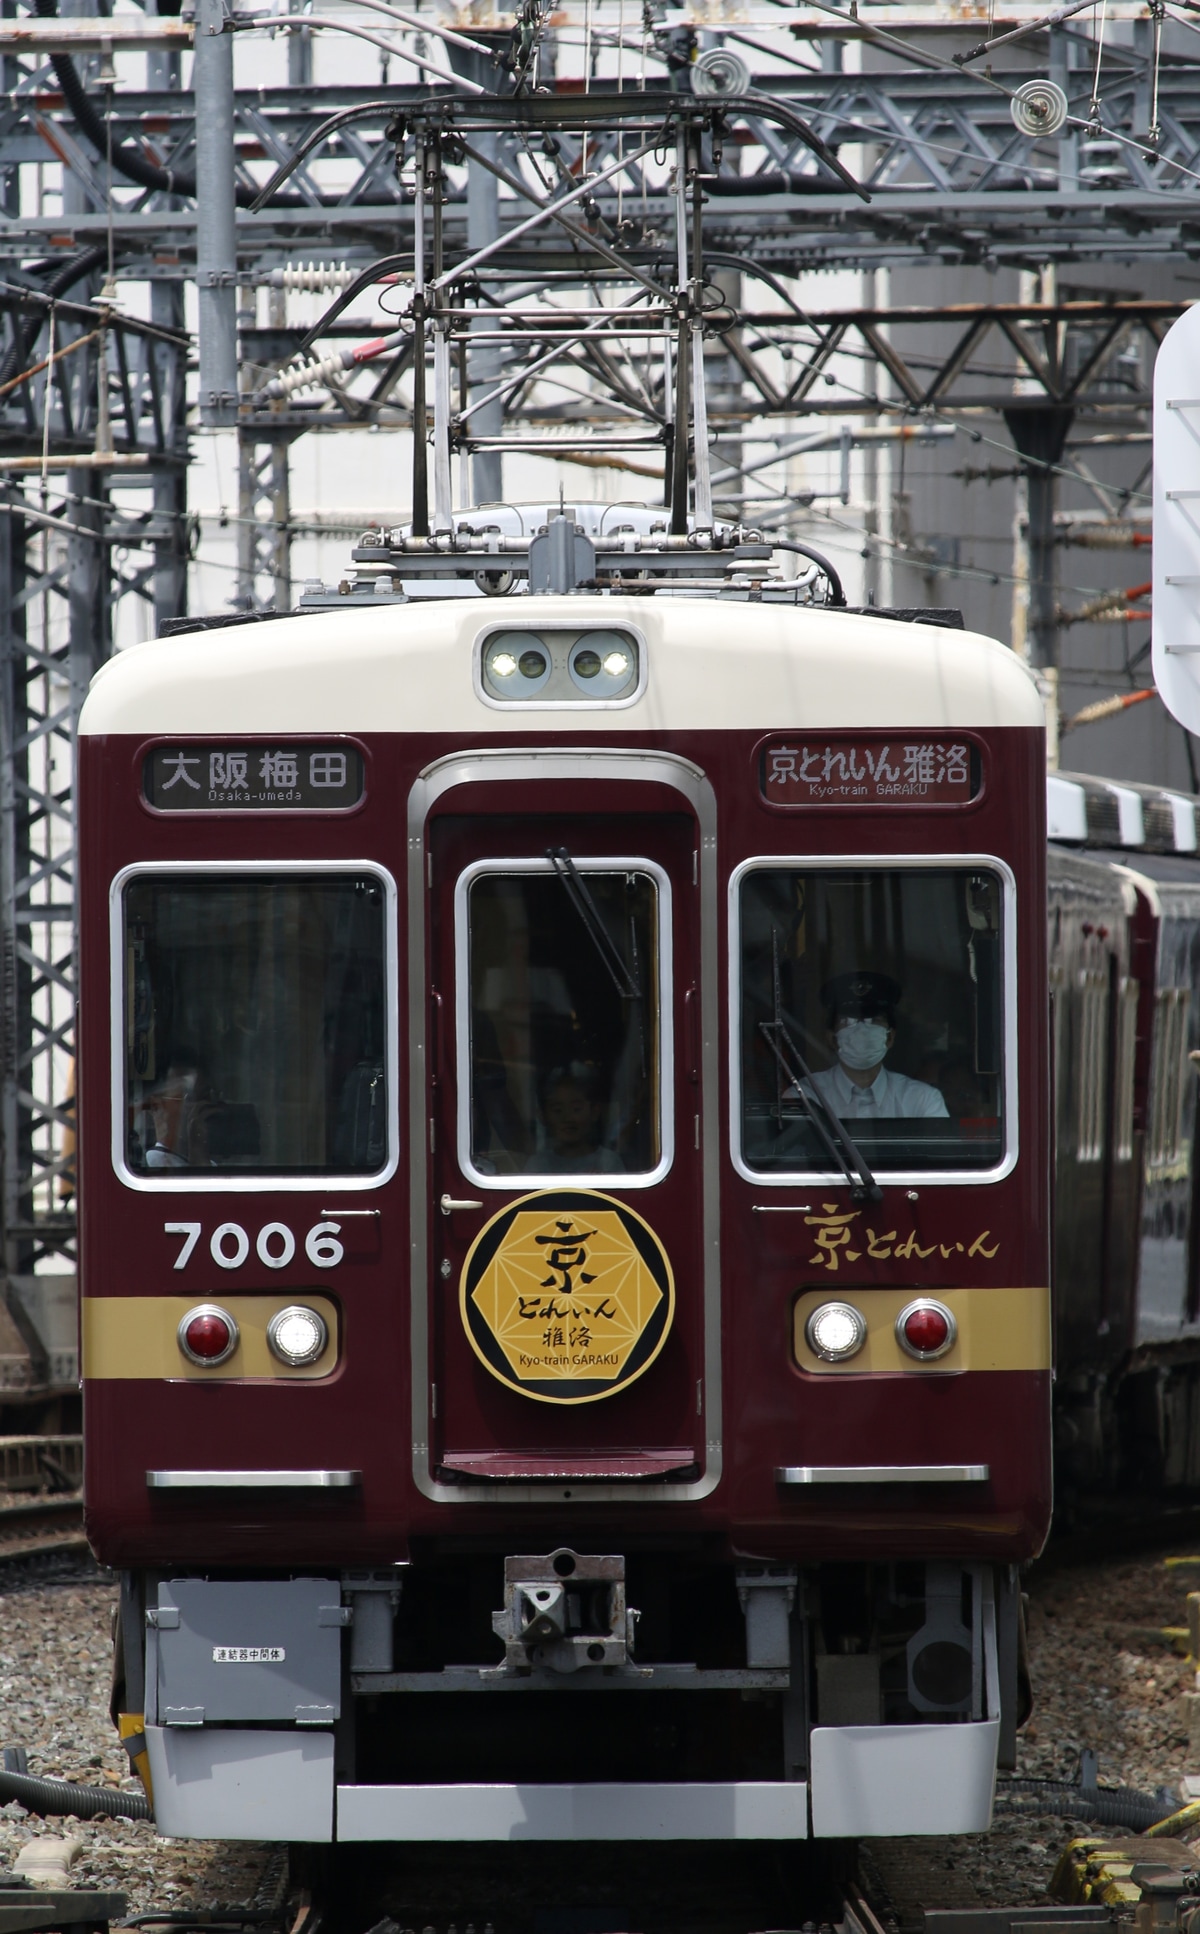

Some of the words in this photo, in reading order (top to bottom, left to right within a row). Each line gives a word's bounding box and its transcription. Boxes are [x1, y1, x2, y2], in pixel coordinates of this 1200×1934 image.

[162, 751, 347, 790] 大阪梅田
[208, 790, 302, 801] Osaka-umeda
[809, 783, 868, 798] Kyo-train
[876, 784, 928, 795] GARAKU
[164, 1221, 344, 1269] 7006
[804, 1203, 1000, 1270] 京とれいん
[534, 1221, 598, 1294] 京
[518, 1296, 617, 1320] とれいん
[542, 1327, 593, 1348] 雅洛
[519, 1354, 570, 1368] Kyo-train
[572, 1354, 619, 1366] GARAKU
